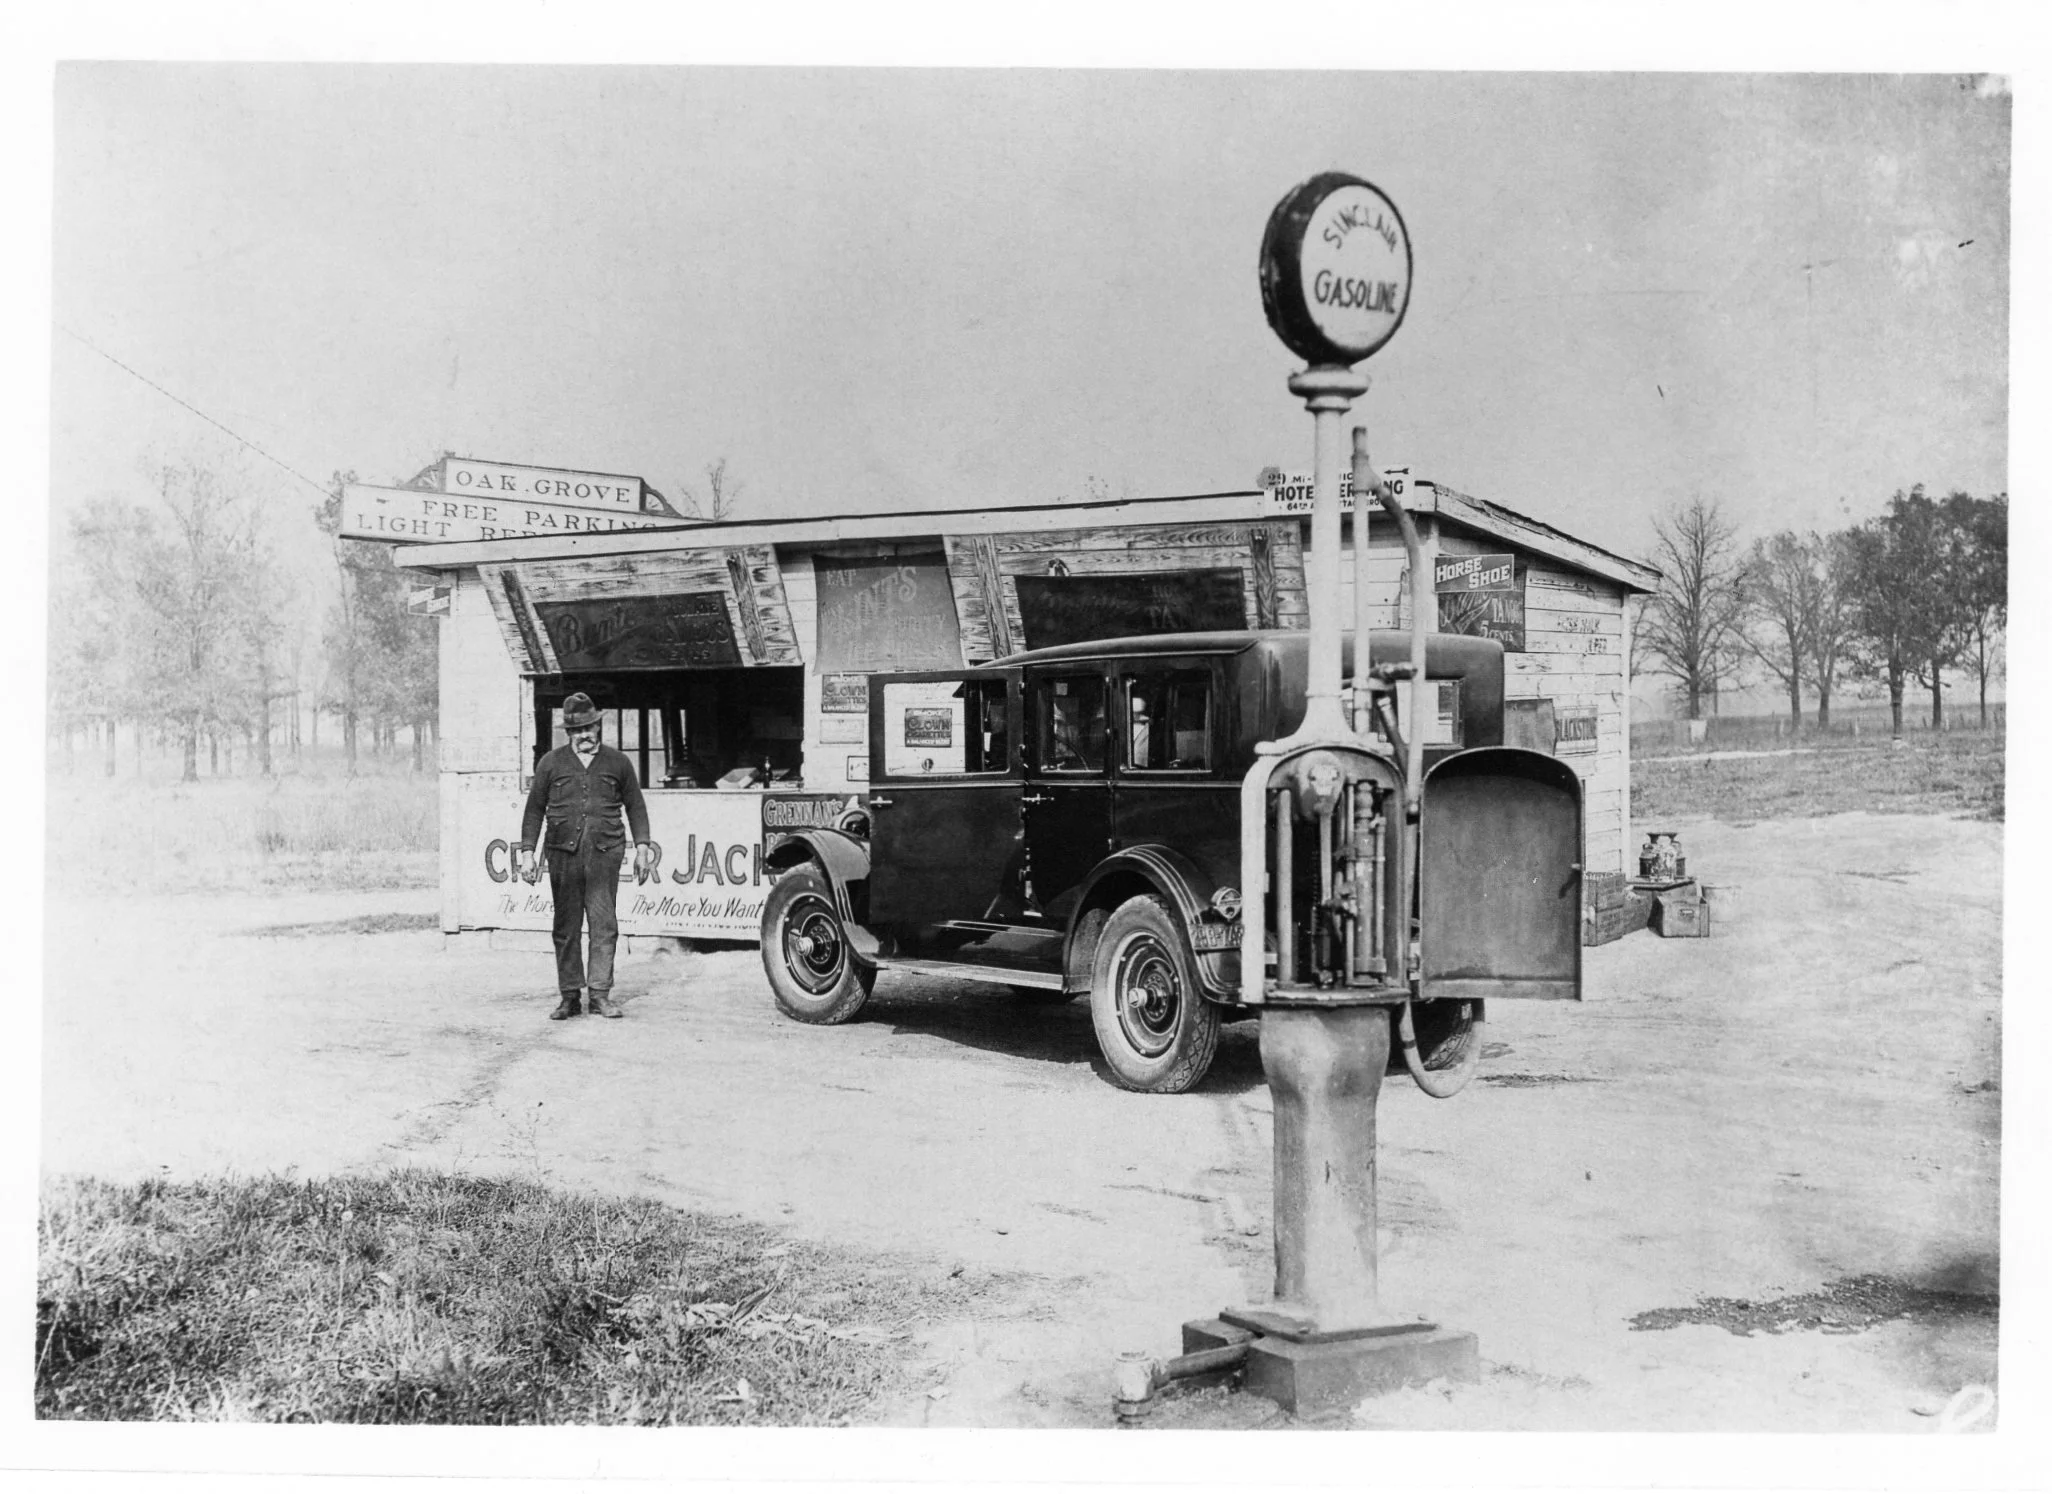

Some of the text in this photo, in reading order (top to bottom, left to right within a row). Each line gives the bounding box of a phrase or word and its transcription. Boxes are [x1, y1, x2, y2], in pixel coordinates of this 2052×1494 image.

[1322, 203, 1398, 253] SINCLAIR
[1314, 269, 1398, 315] GASOLINE
[534, 479, 630, 504] GROVE
[1274, 485, 1315, 502] HOTE
[357, 513, 452, 537] LIGHT
[422, 500, 657, 531] FREE PARKIN
[826, 568, 857, 587] EAT
[1436, 556, 1482, 584] HORSE
[1468, 564, 1511, 590] SHOE
[763, 798, 844, 827] GRENNAN'S
[485, 838, 661, 884] CRER
[631, 893, 656, 915] The
[656, 895, 697, 917] More
[697, 896, 722, 918] You
[723, 898, 764, 919] Want
